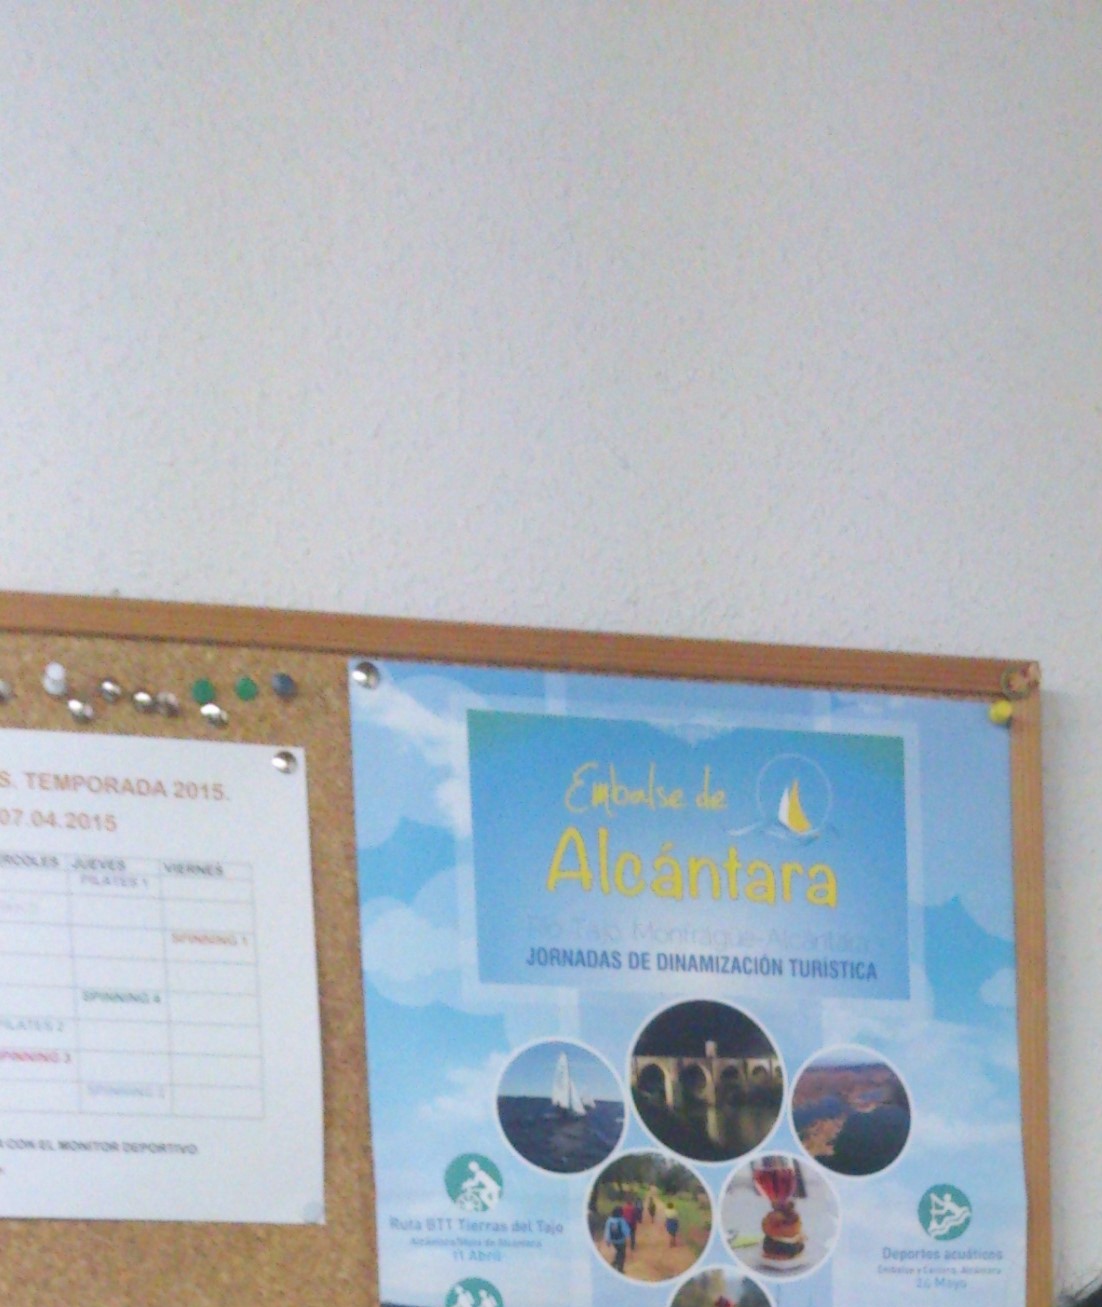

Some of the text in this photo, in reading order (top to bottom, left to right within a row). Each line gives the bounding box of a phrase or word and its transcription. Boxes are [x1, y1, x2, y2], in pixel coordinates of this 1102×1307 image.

[25, 772, 168, 797] TEMPORADA
[173, 780, 230, 801] 2015.
[565, 761, 727, 817] Embalse de
[72, 856, 126, 872] JUEVES
[162, 860, 224, 876] VIERNES
[546, 827, 839, 909] Alcántara
[526, 946, 877, 980] JORNADAS DE DINAMIZACIÓN TURÍSTICA
[389, 1216, 422, 1231] Ruta
[458, 1218, 508, 1233] Tierras
[512, 1218, 532, 1233] del
[536, 1219, 564, 1235] Tajo
[469, 1249, 503, 1262] Abril
[882, 1246, 1003, 1261] Deportes acuáticos
[934, 1277, 968, 1291] Mayo
